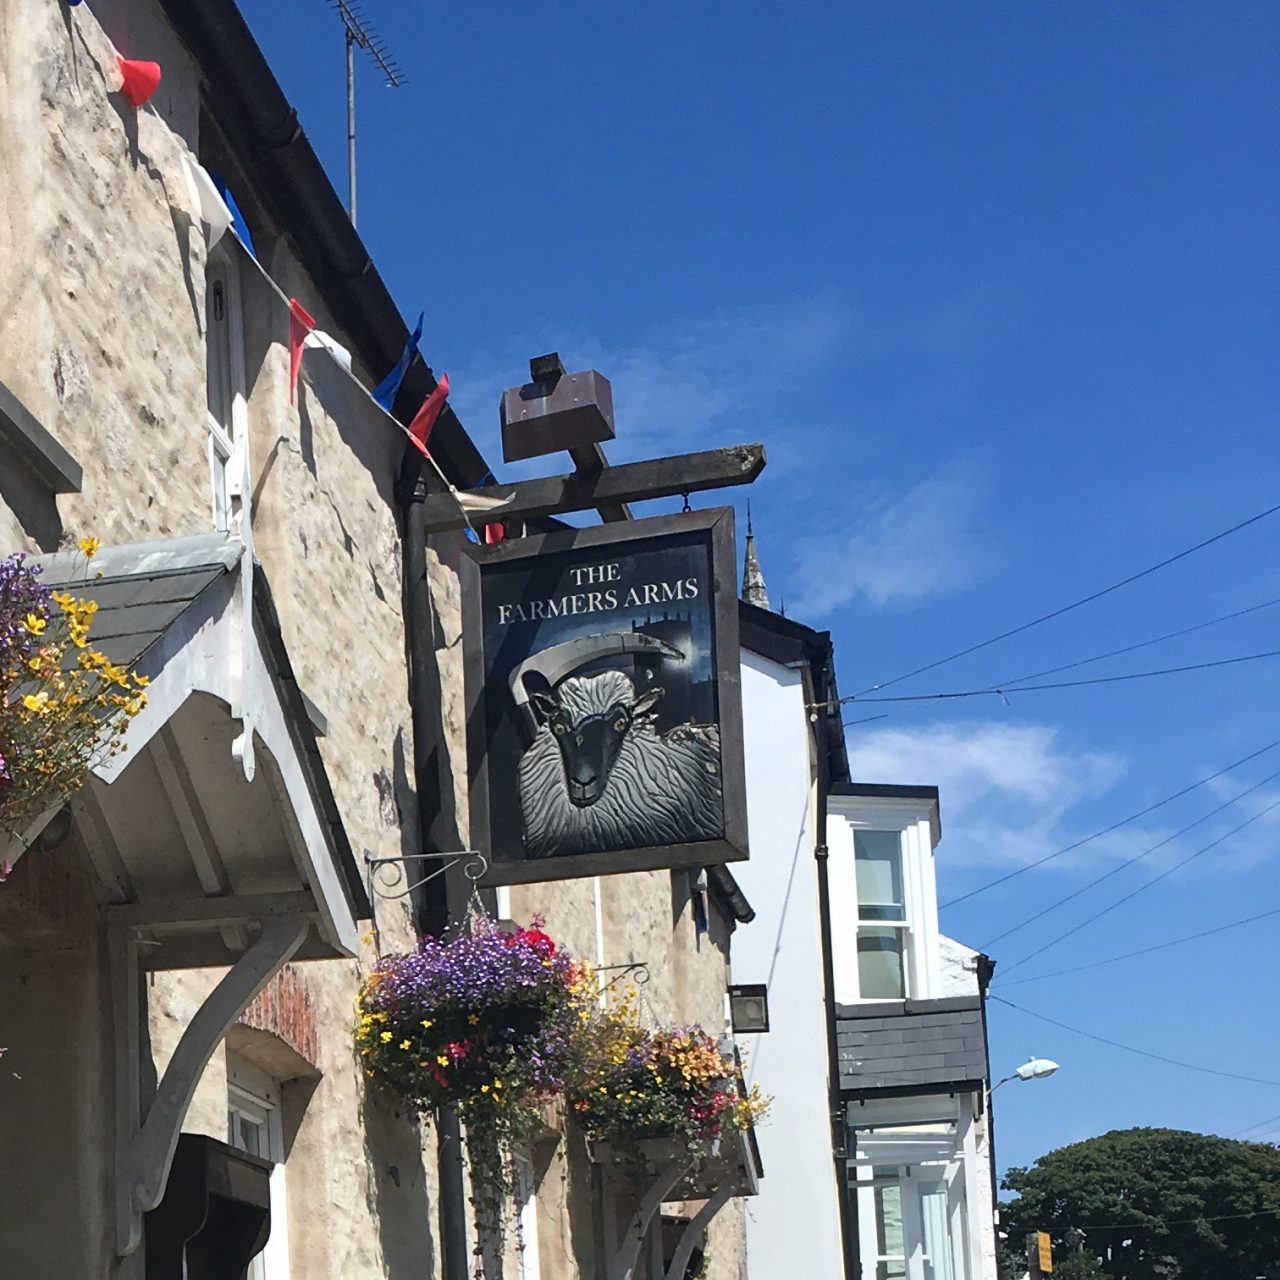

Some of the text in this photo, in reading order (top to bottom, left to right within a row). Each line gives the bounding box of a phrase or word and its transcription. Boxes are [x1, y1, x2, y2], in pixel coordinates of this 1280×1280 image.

[570, 563, 621, 586] THE
[498, 578, 699, 625] FARMERS ARMS
